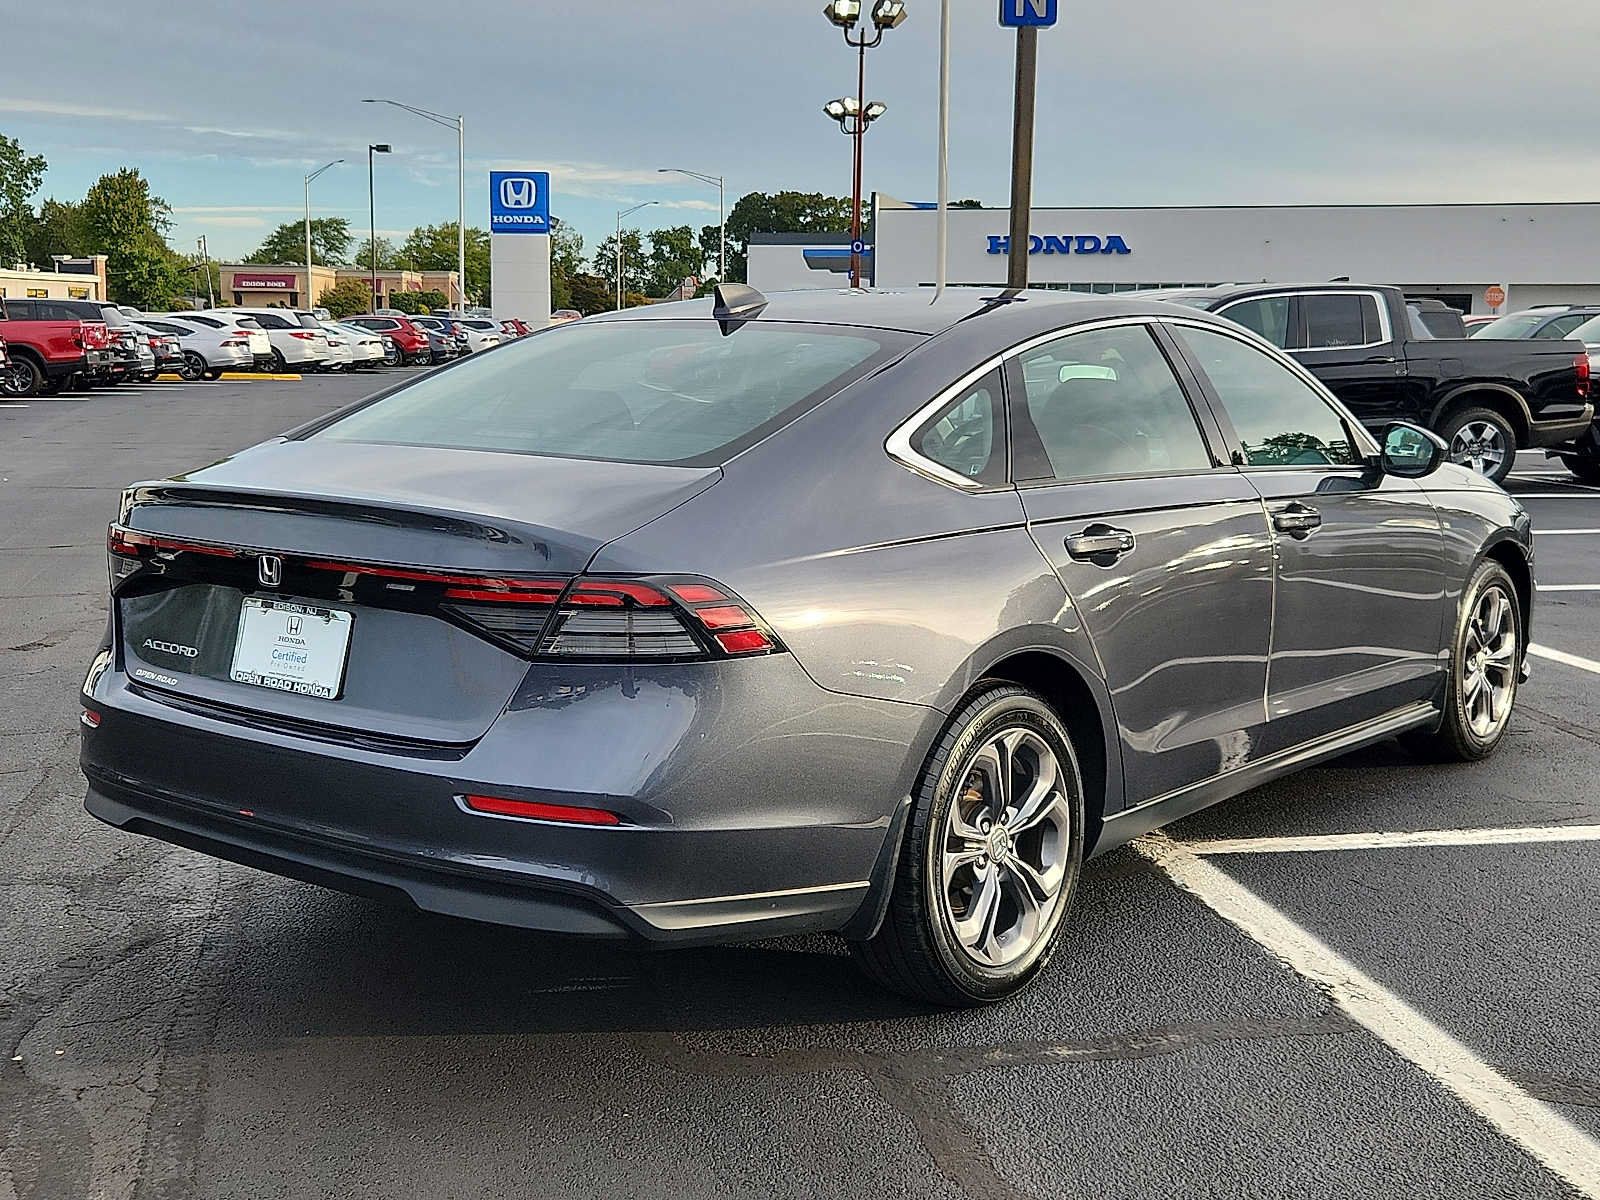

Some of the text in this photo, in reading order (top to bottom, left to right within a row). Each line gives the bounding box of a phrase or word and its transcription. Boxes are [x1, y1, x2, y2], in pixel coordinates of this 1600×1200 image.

[492, 215, 545, 224] HONDA
[986, 235, 1132, 255] HONDA
[1485, 292, 1504, 302] STOP
[306, 607, 318, 615] NJ
[142, 638, 199, 658] ACCORD
[278, 635, 307, 647] HONDA
[272, 649, 308, 664] Certified
[135, 669, 178, 686] OPEN ROAD
[236, 671, 262, 685] OPEN
[263, 676, 292, 691] ROAD
[293, 682, 330, 698] HONDA
